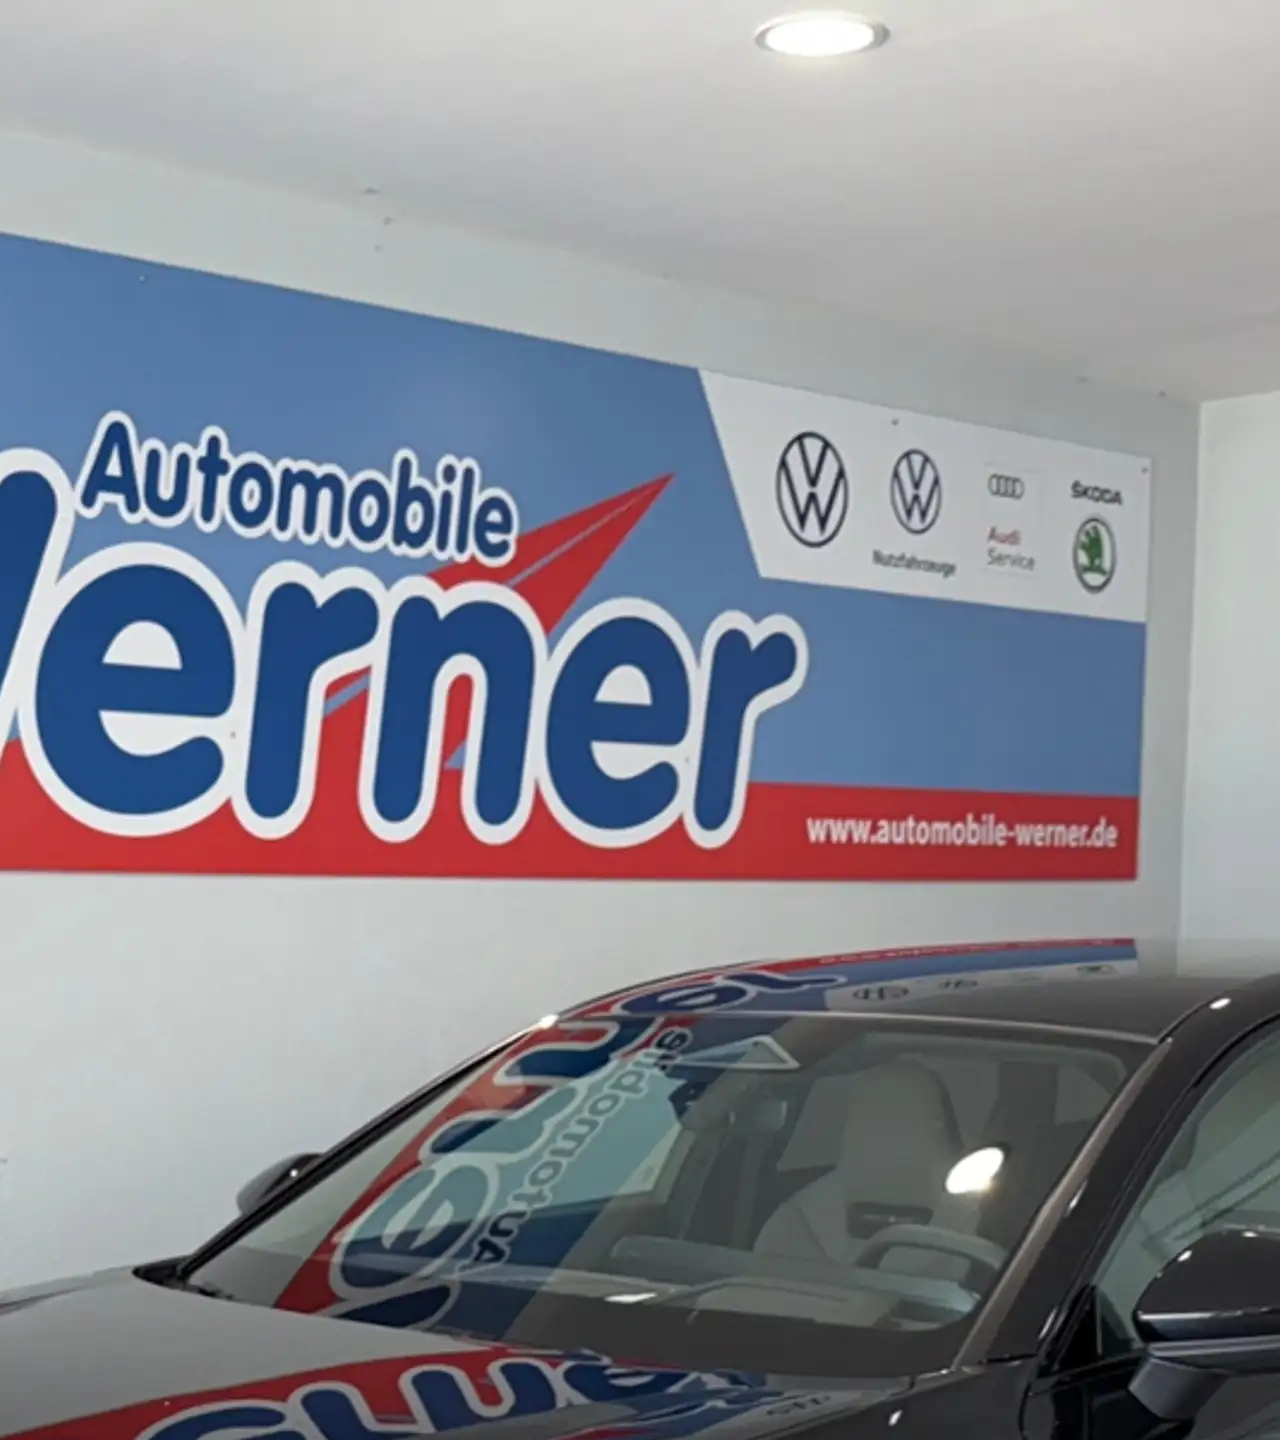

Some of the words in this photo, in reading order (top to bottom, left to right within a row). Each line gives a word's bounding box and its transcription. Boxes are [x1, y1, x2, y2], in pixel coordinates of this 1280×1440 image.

[84, 416, 516, 562] Automobile
[987, 526, 1023, 546] Audi
[872, 549, 957, 578] Nutzfahrzeuge
[986, 548, 1037, 572] Service
[806, 815, 1119, 848] www.automobile-werner.de
